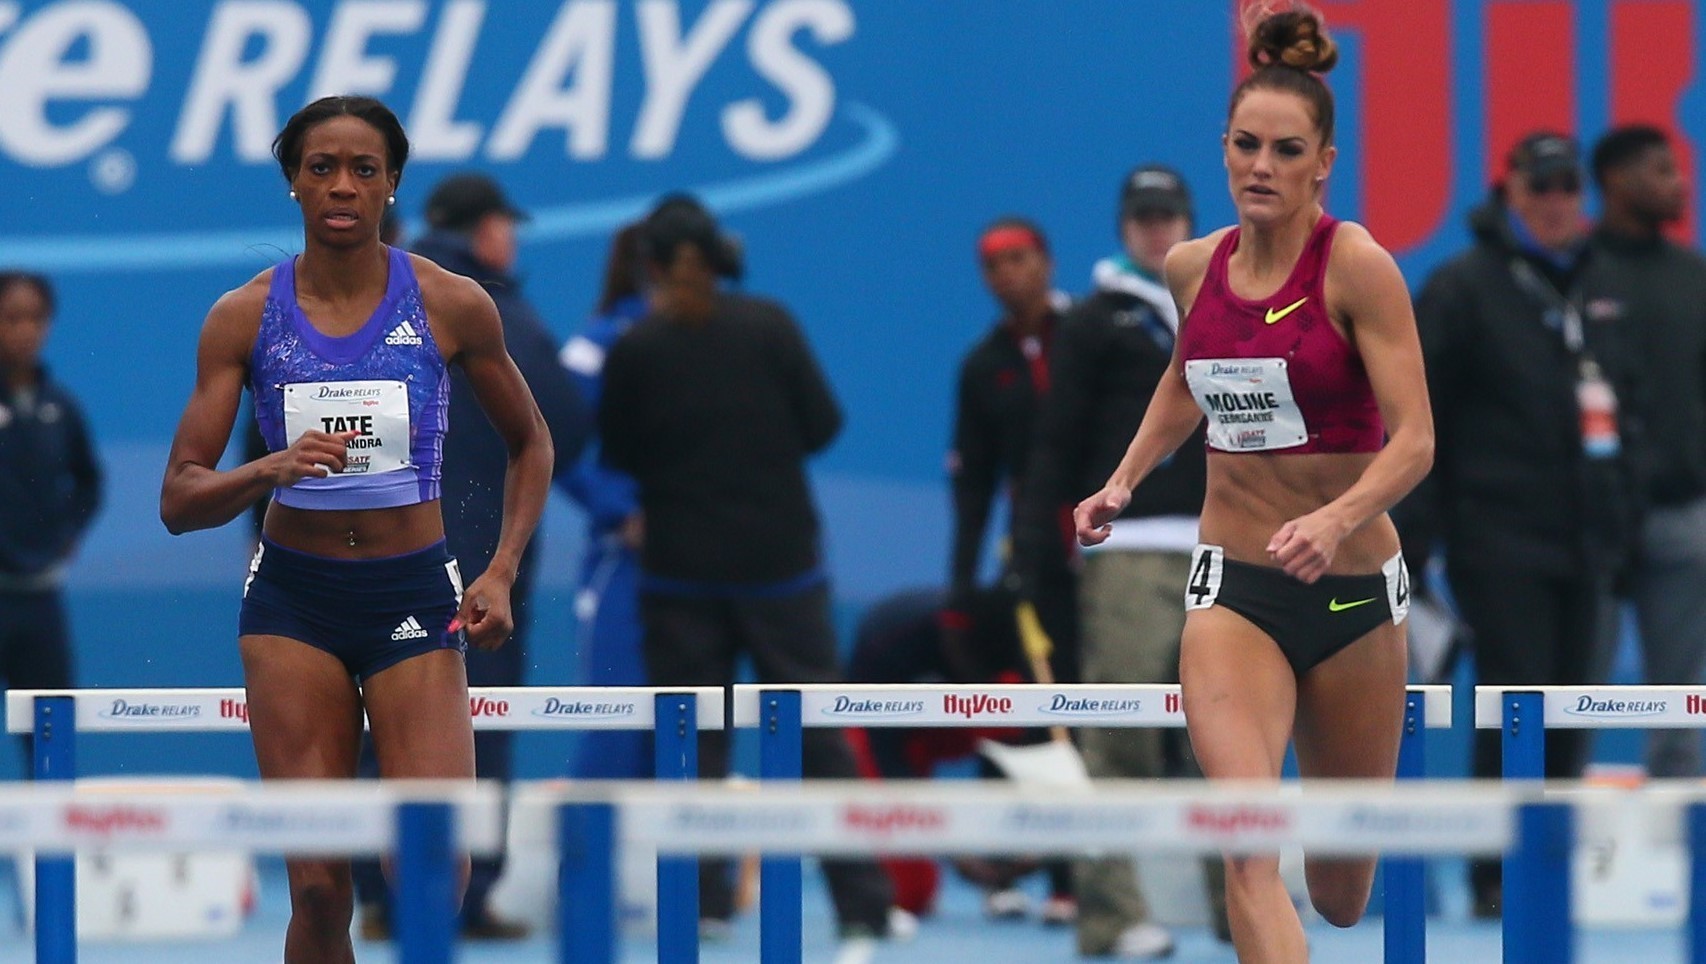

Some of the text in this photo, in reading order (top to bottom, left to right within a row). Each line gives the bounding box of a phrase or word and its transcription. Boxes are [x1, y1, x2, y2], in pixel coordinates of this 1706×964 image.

[168, 0, 856, 164] RELAYS
[385, 336, 422, 345] adidas
[318, 386, 381, 398] Drake RELAYS
[1205, 392, 1279, 412] MOLINE
[321, 415, 373, 436] TATE
[345, 438, 383, 449] ANDRA
[1190, 550, 1212, 605] 4
[391, 630, 428, 641] adidas
[111, 699, 201, 716] Drake RELAYS
[470, 697, 510, 717] Vee
[544, 697, 635, 714] Drake RELAYS
[834, 695, 924, 712] Drake RELAYS
[943, 694, 1012, 719] HyVee
[1050, 693, 1141, 711] Drake RELAYS
[1576, 695, 1666, 712] Drake RELAYS
